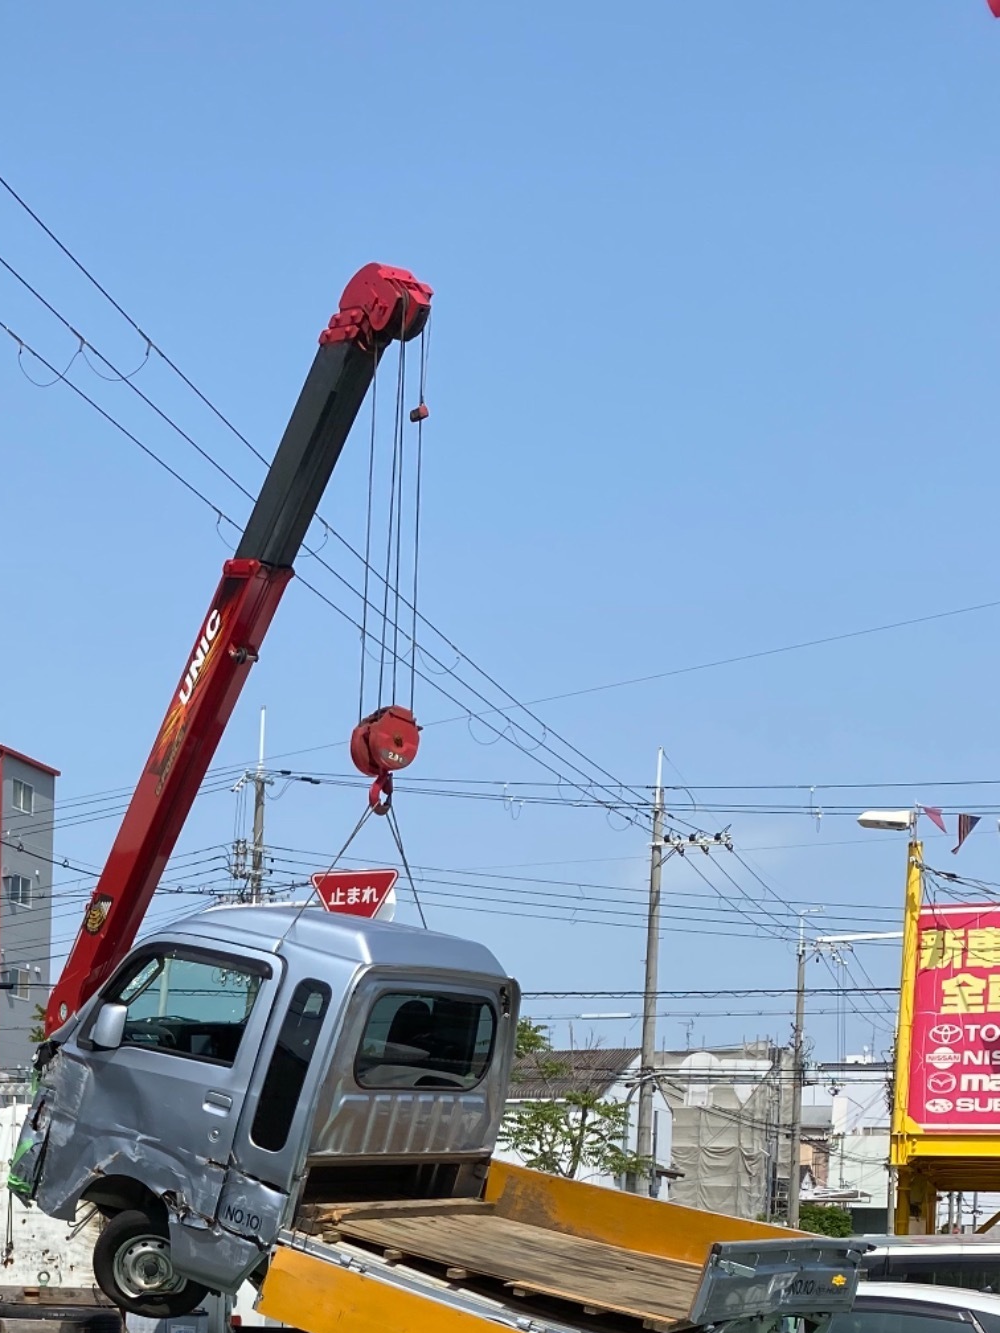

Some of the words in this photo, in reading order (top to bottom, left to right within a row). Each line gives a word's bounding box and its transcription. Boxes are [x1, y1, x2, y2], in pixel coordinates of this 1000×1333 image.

[179, 609, 221, 705] UNIC
[328, 886, 379, 906] 止まれ
